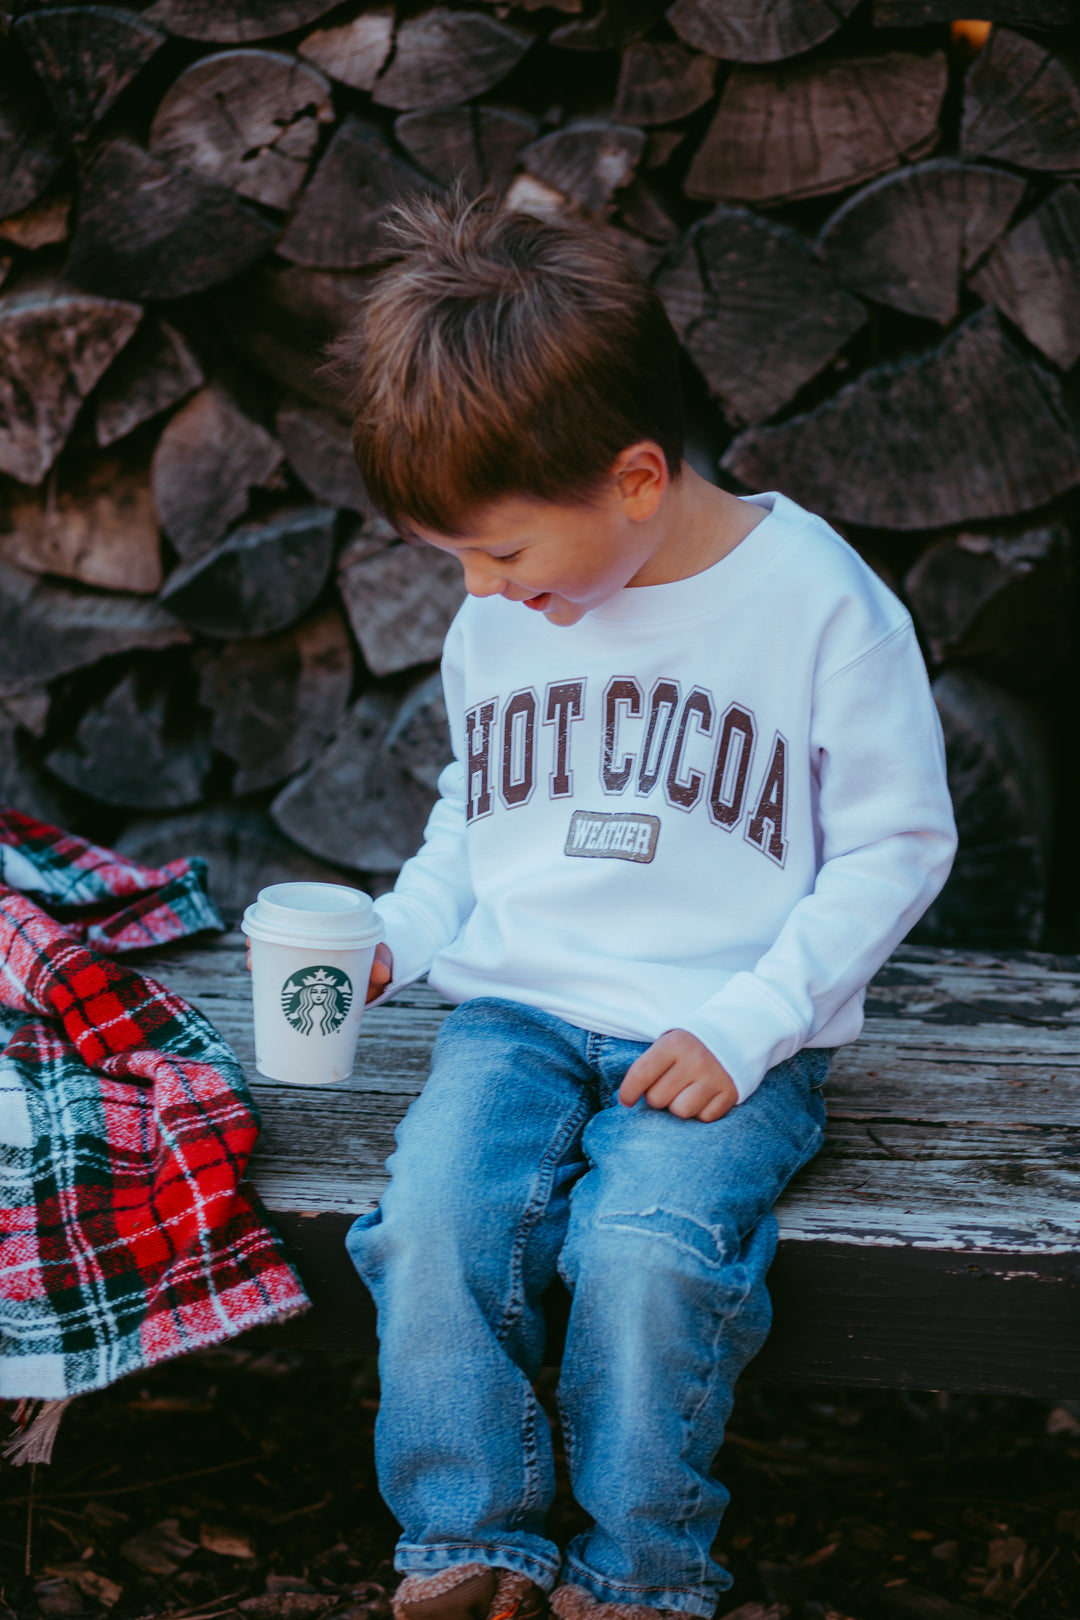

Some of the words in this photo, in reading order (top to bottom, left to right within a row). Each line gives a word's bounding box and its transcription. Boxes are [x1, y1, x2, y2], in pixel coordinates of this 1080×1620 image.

[464, 676, 587, 827] HOT
[600, 675, 788, 869] COCOA
[572, 819, 652, 855] WEATHER
